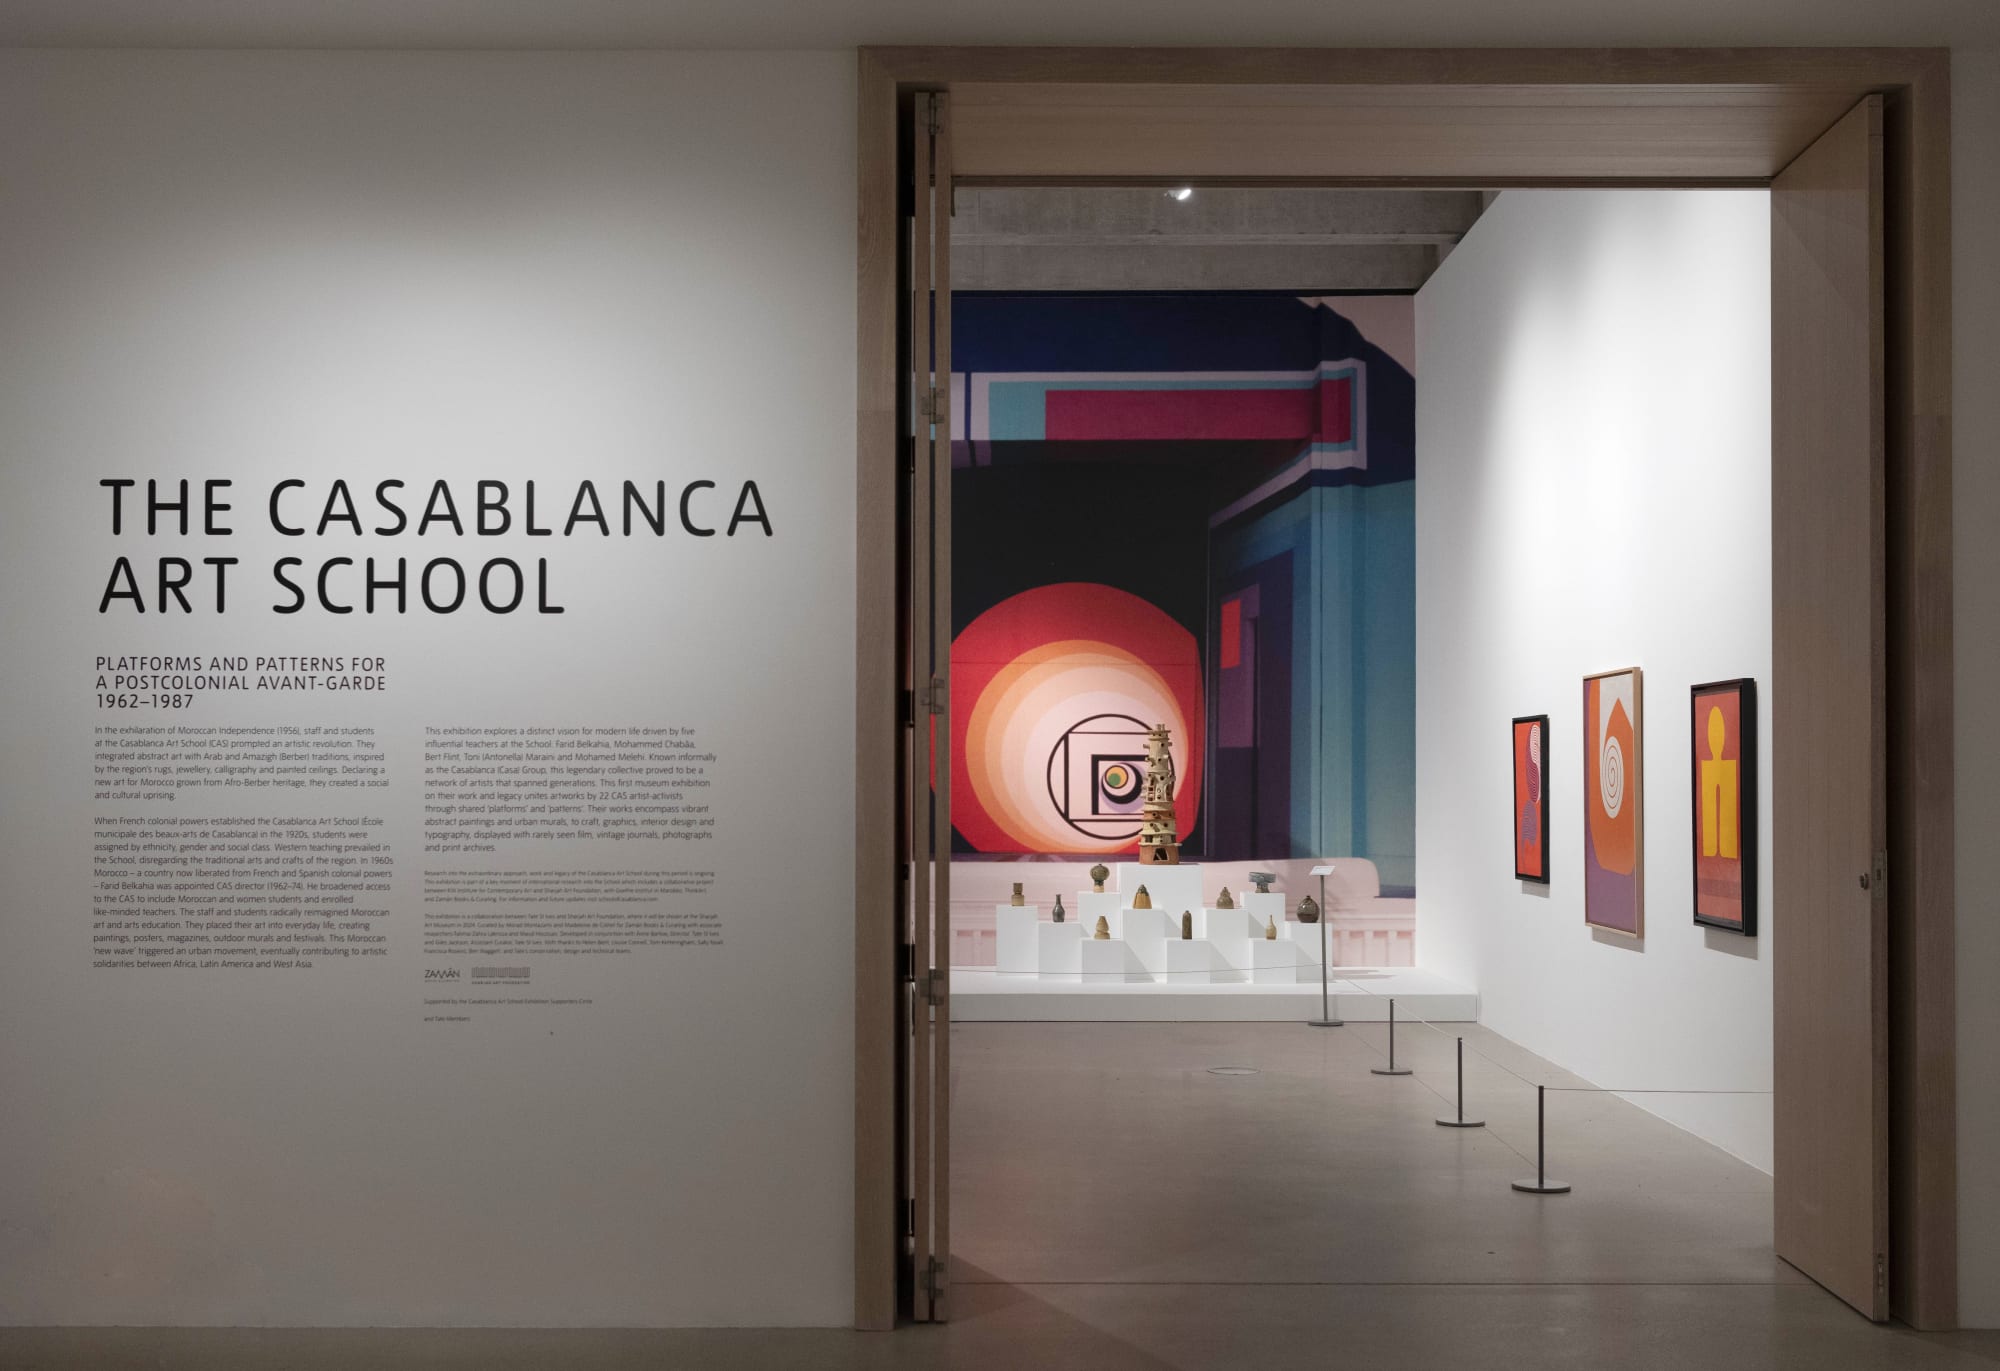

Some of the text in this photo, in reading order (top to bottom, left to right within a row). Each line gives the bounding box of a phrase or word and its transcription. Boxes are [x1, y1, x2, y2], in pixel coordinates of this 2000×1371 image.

[100, 479, 773, 537] THE CASABLANCA
[99, 557, 564, 614] ART SCHOOL
[97, 657, 384, 671] PLATFORMS AND PATTERNS FOR
[96, 675, 385, 690] A POSTCOLONIAL AVANT-GARDE
[95, 725, 102, 734] In
[105, 725, 118, 734] the
[120, 725, 165, 734] exhilaration
[167, 725, 175, 734] of
[177, 725, 217, 734] Moroccan
[219, 726, 275, 737] Independence
[304, 726, 322, 735] staff
[323, 726, 339, 735] and
[340, 726, 374, 735] students
[426, 726, 441, 735] This
[443, 726, 482, 735] exhibition
[484, 726, 517, 737] explores
[526, 726, 555, 735] distinct
[557, 726, 580, 735] vision
[582, 726, 593, 735] for
[595, 726, 626, 735] modern
[629, 726, 640, 735] life
[642, 726, 667, 735] driven
[669, 726, 679, 737] by
[681, 726, 695, 735] five
[95, 738, 102, 747] at
[105, 738, 118, 747] the
[119, 738, 164, 747] Casablanca
[166, 738, 178, 747] Art
[180, 738, 207, 747] School
[230, 739, 271, 750] prompted
[284, 739, 311, 747] artistic
[356, 739, 375, 750] They
[95, 751, 135, 763] integrated
[137, 751, 169, 760] abstract
[171, 751, 182, 760] art
[184, 751, 202, 760] with
[203, 751, 223, 760] Arab
[224, 751, 240, 760] and
[242, 751, 277, 763] Amazigh
[352, 752, 384, 763] inspired
[95, 764, 104, 776] by
[107, 764, 120, 773] the
[214, 765, 257, 776] calligraphy
[259, 765, 274, 773] and
[276, 765, 307, 776] painted
[342, 765, 378, 776] Declaring
[114, 777, 125, 786] art
[126, 777, 138, 786] for
[140, 777, 174, 786] Morocco
[176, 779, 201, 788] grown
[204, 777, 222, 786] from
[224, 777, 270, 786] Afro-Berber
[309, 778, 327, 789] they
[328, 778, 358, 787] created
[367, 778, 389, 787] social
[425, 778, 458, 786] network
[459, 778, 468, 786] of
[469, 778, 494, 786] artists
[496, 778, 511, 786] that
[513, 778, 548, 789] spanned
[600, 778, 616, 787] This
[618, 778, 632, 787] first
[671, 778, 710, 787] exhibition
[95, 790, 110, 799] and
[112, 790, 141, 799] cultural
[437, 791, 456, 799] their
[457, 791, 477, 799] work
[479, 791, 495, 799] and
[497, 791, 522, 802] legacy
[524, 791, 548, 800] unites
[550, 791, 585, 800] artworks
[587, 791, 597, 802] by
[599, 791, 609, 800] 22
[611, 791, 627, 800] CAS
[629, 791, 683, 800] artist-activists
[94, 816, 117, 824] When
[119, 816, 145, 825] French
[147, 816, 177, 825] colonial
[179, 818, 209, 827] powers
[211, 816, 255, 825] established
[258, 816, 271, 825] the
[272, 816, 317, 825] Casablanca
[318, 817, 331, 825] Art
[333, 817, 359, 825] School
[425, 842, 440, 851] and
[442, 842, 461, 854] print
[94, 894, 102, 902] to
[104, 894, 117, 902] the
[119, 894, 135, 903] CAS
[137, 894, 145, 903] to
[147, 894, 176, 903] include
[178, 894, 217, 903] Moroccan
[219, 894, 234, 903] and
[268, 894, 302, 903] students
[304, 894, 319, 903] and
[321, 894, 353, 903] enrolled
[94, 906, 140, 915] like-minded
[179, 907, 195, 916] The
[196, 907, 214, 916] staff
[216, 907, 231, 916] and
[234, 907, 268, 916] students
[269, 907, 302, 919] radically
[304, 907, 349, 919] reimagined
[351, 908, 389, 916] Moroccan
